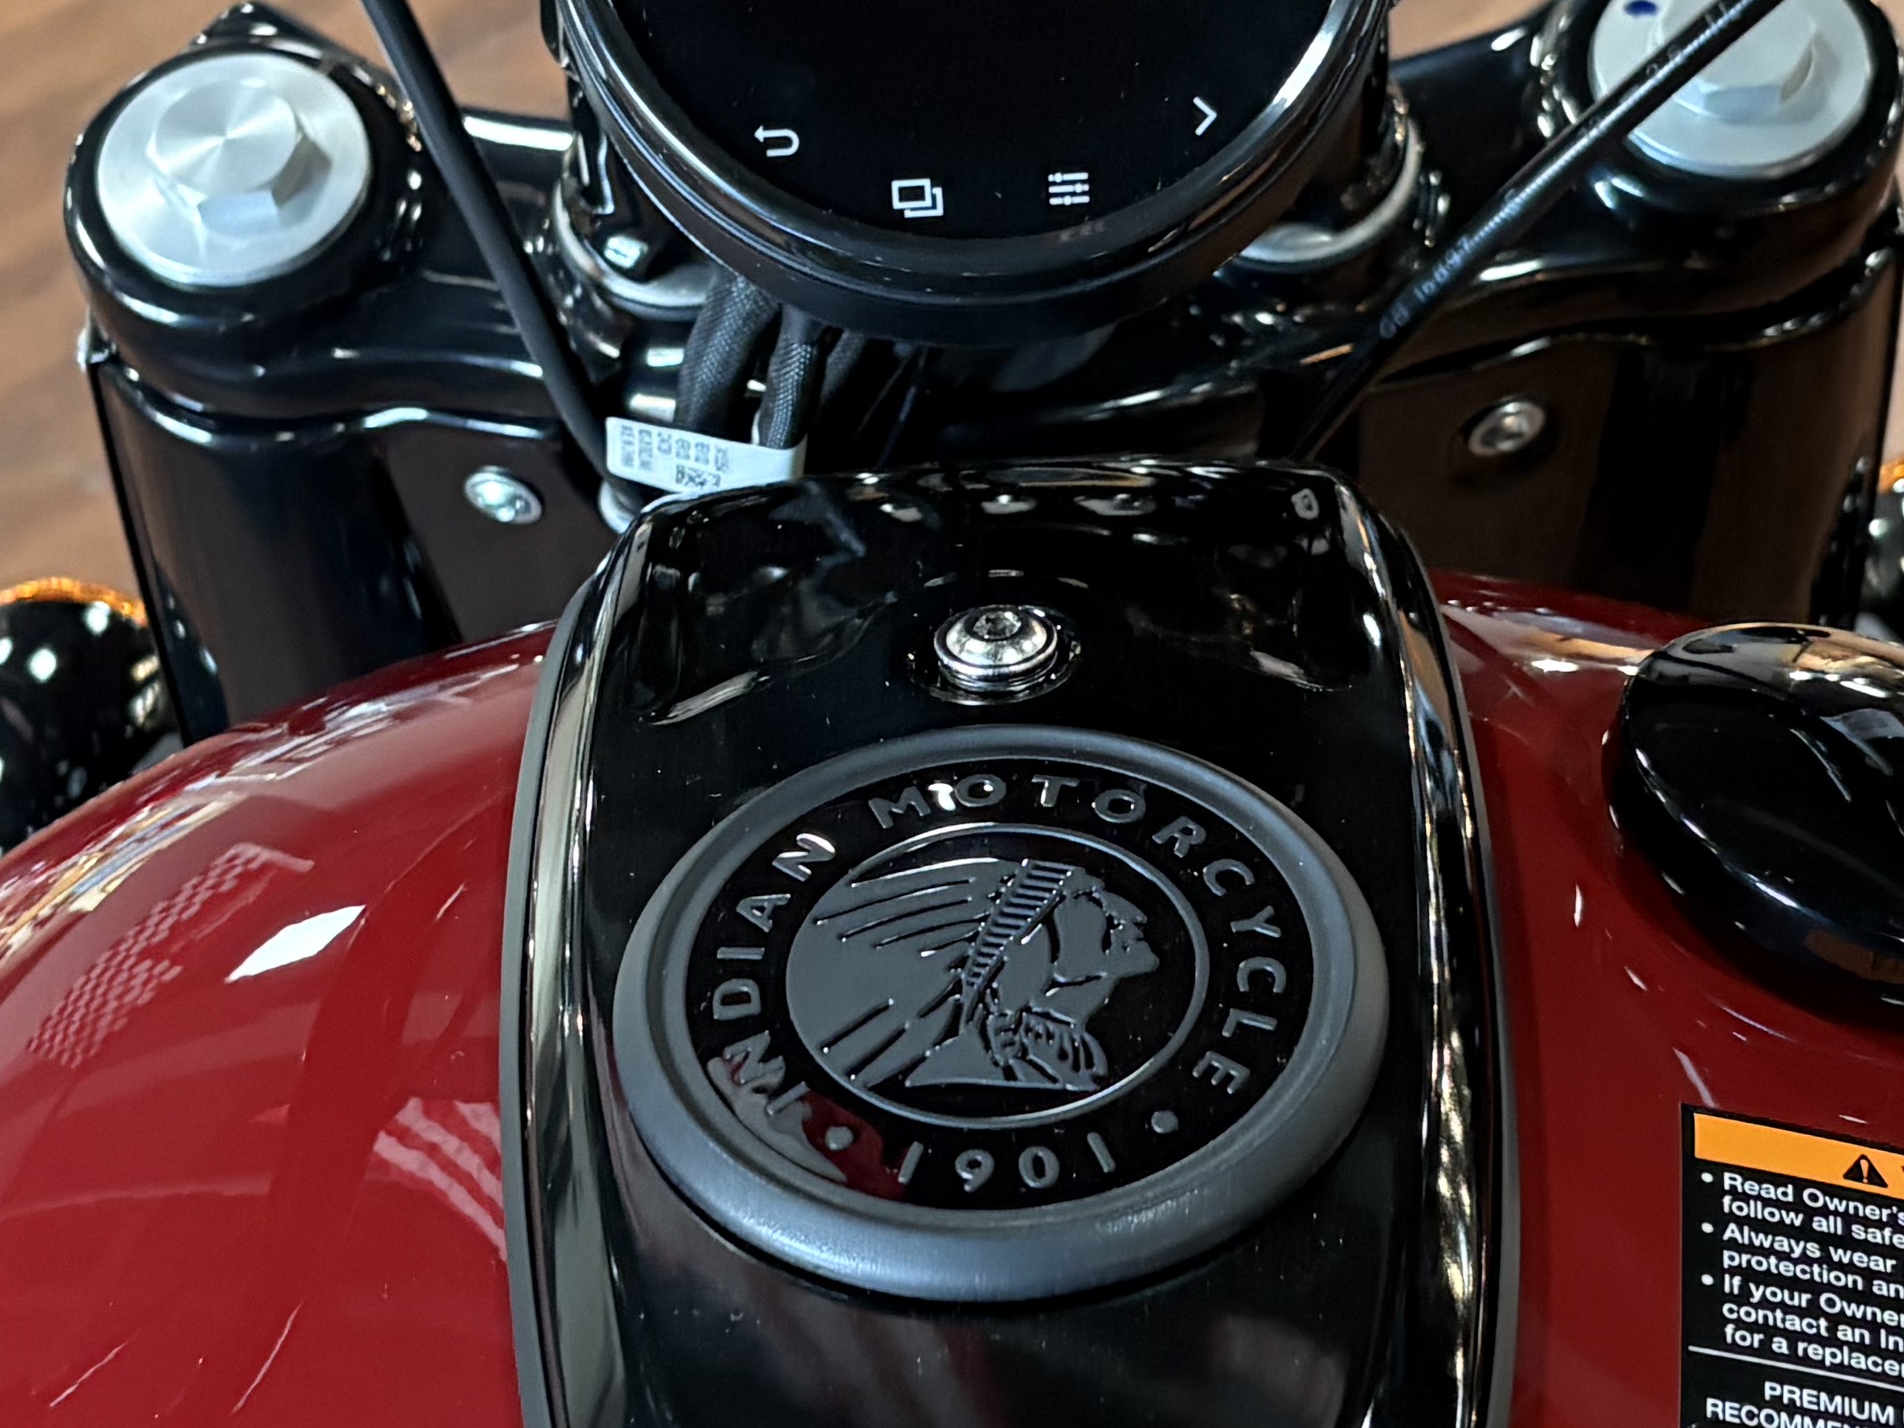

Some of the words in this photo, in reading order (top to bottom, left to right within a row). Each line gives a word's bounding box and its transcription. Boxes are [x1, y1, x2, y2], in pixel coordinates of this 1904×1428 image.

[709, 832, 836, 1117] INDIAN
[867, 772, 1288, 1096] MOTORCYCLE
[897, 1132, 1116, 1194] 1901
[1723, 1172, 1793, 1202] Read
[1722, 1195, 1803, 1227] follow
[1812, 1216, 1843, 1235] all
[1722, 1223, 1821, 1259] Always
[1829, 1246, 1896, 1273] wear
[1722, 1250, 1863, 1291] protection
[1724, 1274, 1741, 1295] If
[1749, 1282, 1812, 1307] your
[1722, 1303, 1829, 1337] contact
[1836, 1324, 1871, 1345] an
[1724, 1324, 1764, 1349] for
[1771, 1337, 1790, 1355] a
[1764, 1381, 1894, 1426] PREMIUM
